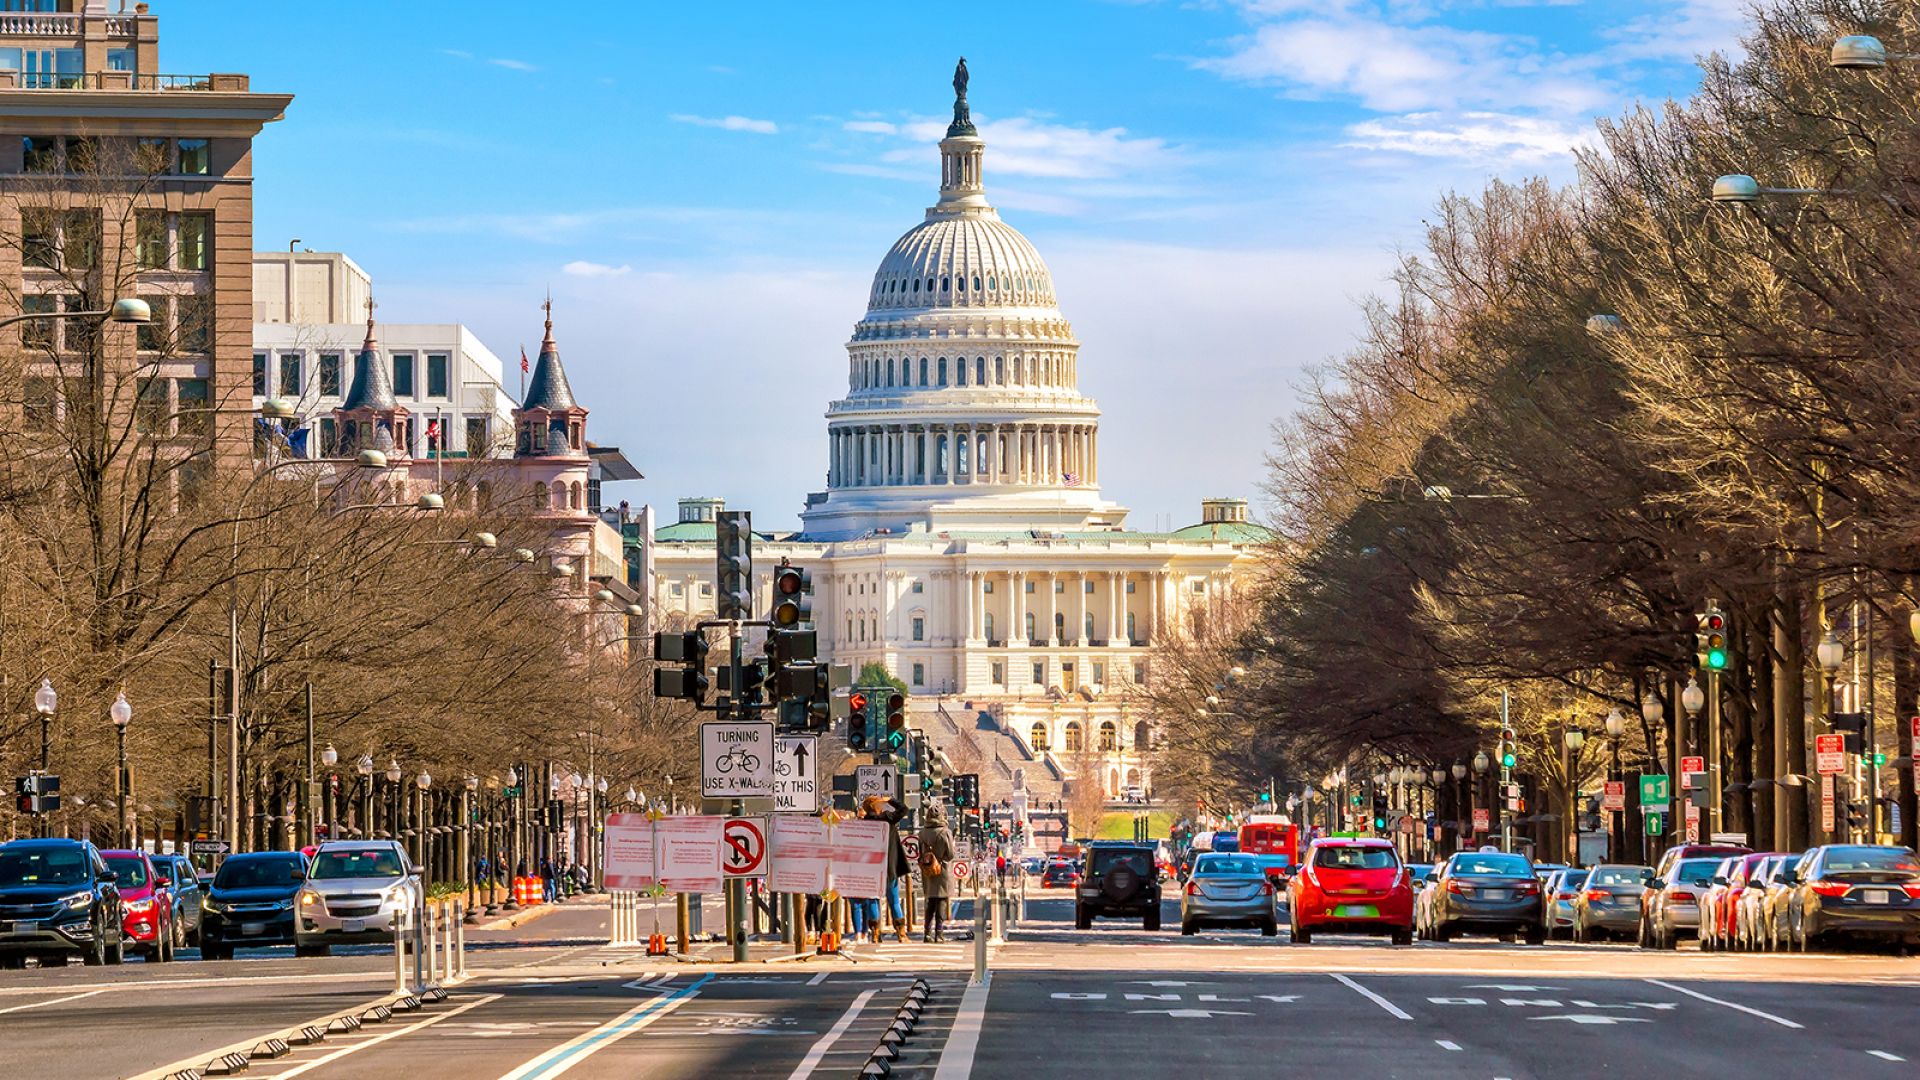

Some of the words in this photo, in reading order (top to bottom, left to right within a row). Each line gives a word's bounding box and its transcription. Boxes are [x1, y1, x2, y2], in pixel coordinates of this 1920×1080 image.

[717, 731, 759, 742] TURNING
[775, 741, 787, 753] RU
[705, 778, 724, 789] USE
[775, 781, 788, 793] EY
[792, 781, 813, 792] THIS
[776, 796, 796, 808] NAL
[1051, 993, 1303, 1002] ONLY
